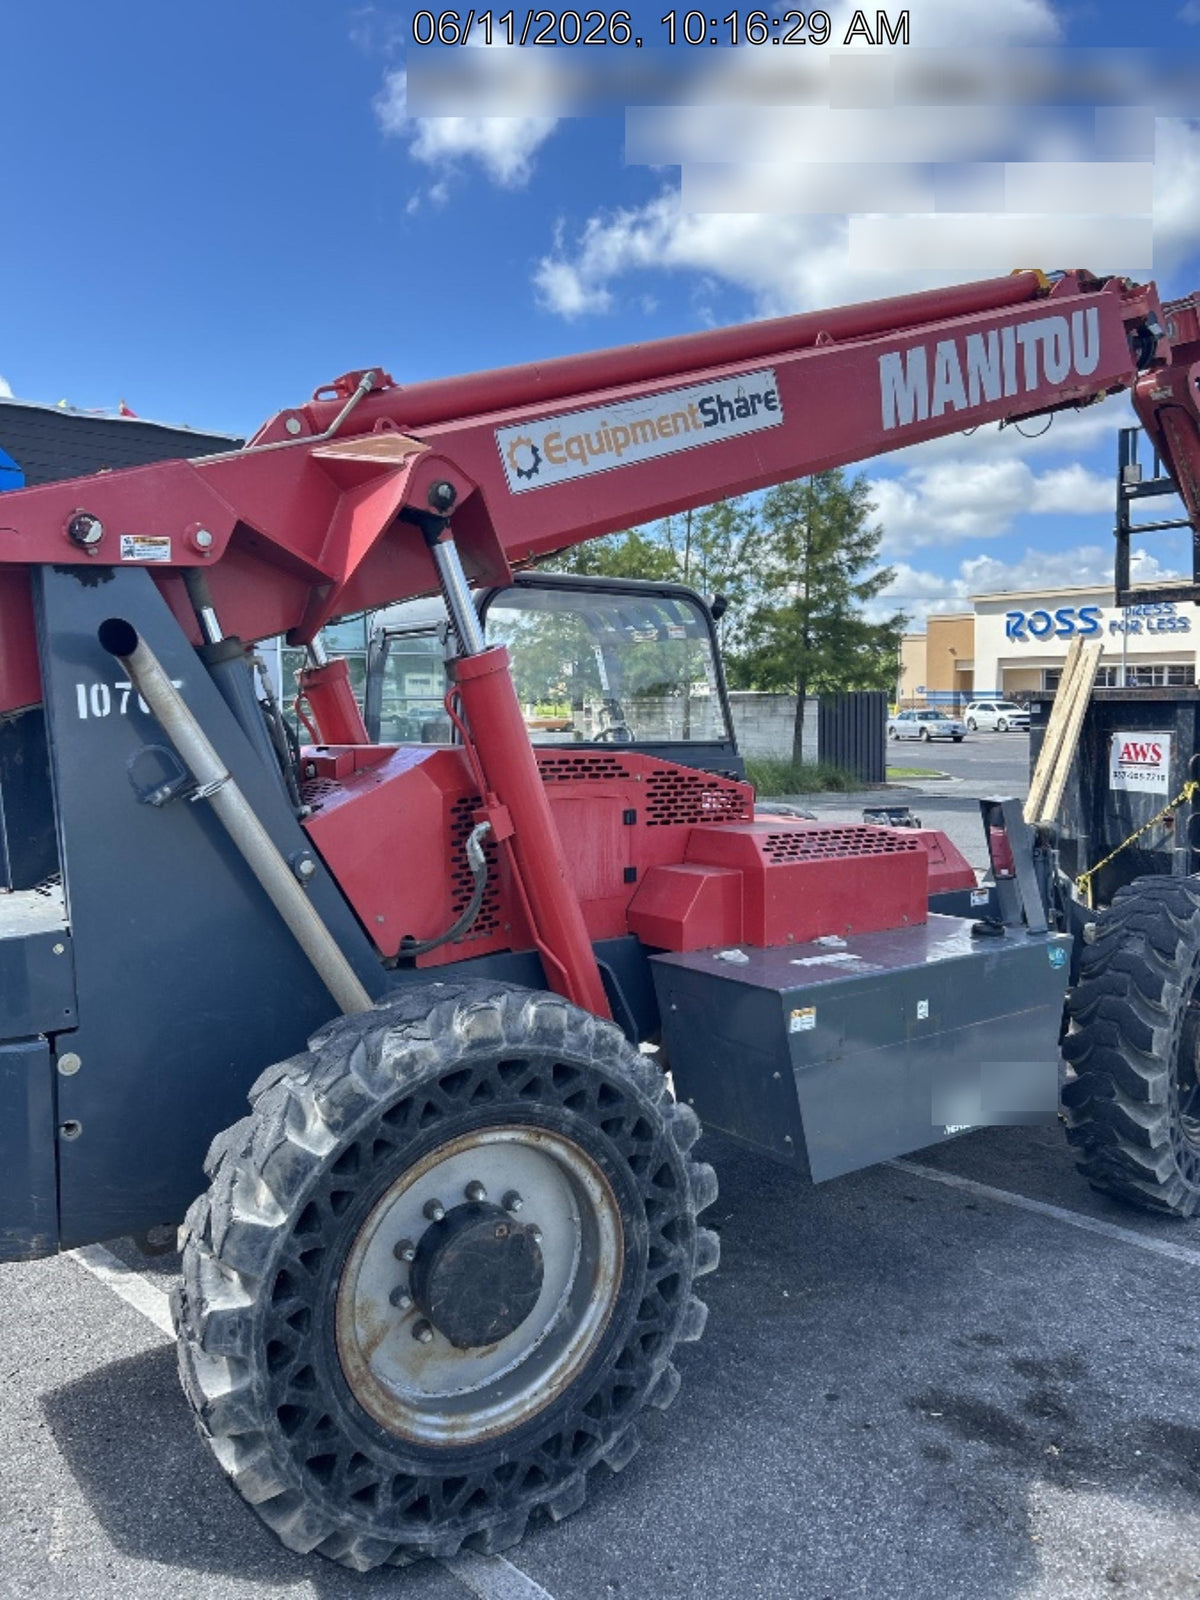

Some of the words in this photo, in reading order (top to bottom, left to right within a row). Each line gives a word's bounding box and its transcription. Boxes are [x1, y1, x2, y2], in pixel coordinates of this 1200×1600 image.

[878, 307, 1100, 431] MANITOU
[543, 388, 779, 466] EquipmentShare
[1005, 606, 1100, 638] ROSS
[1109, 619, 1139, 634] FOR
[1146, 617, 1190, 631] LESS
[75, 680, 184, 719] 107
[1118, 742, 1162, 762] AWS
